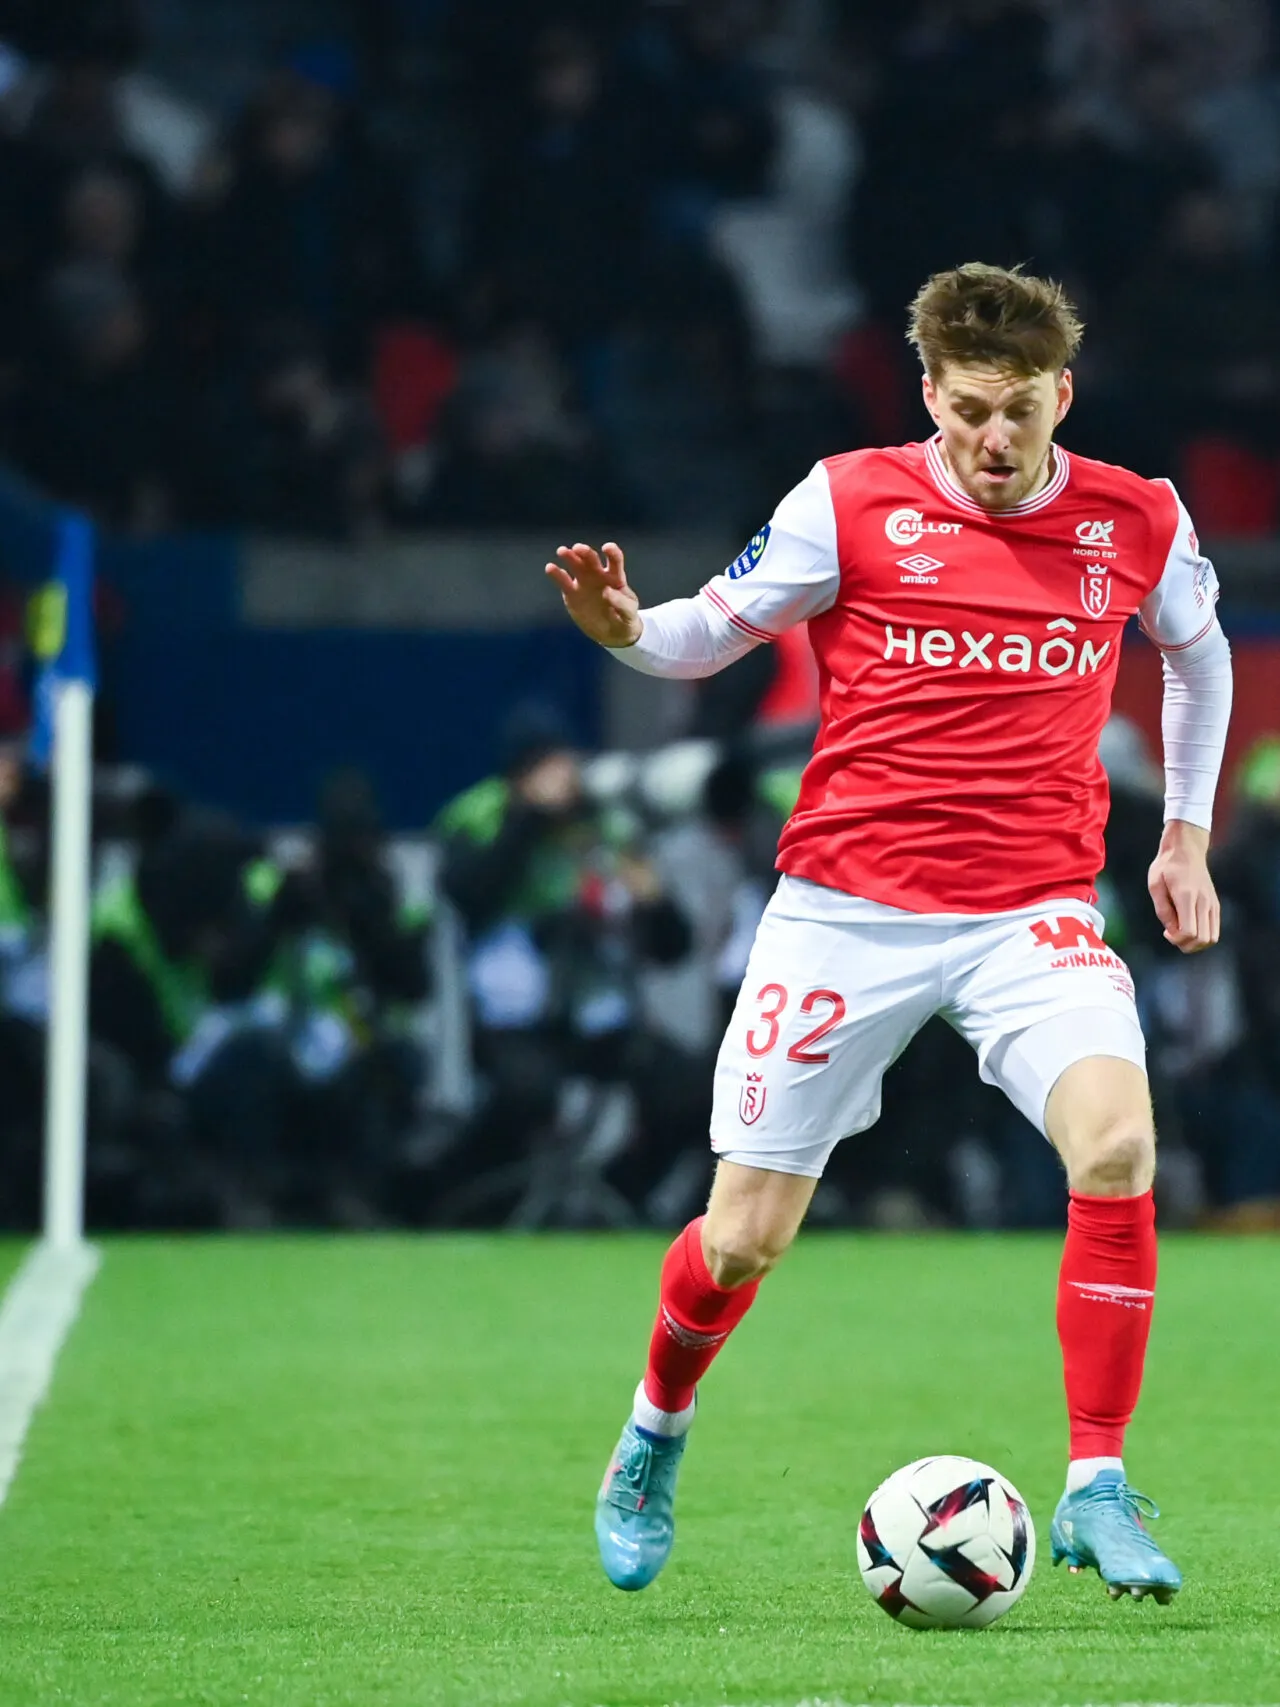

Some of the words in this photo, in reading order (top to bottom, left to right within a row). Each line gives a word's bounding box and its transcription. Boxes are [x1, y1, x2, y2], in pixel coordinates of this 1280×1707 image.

[1073, 547, 1100, 558] NORD
[1101, 550, 1118, 559] EST
[899, 573, 939, 585] umbro
[745, 982, 847, 1064] 32
